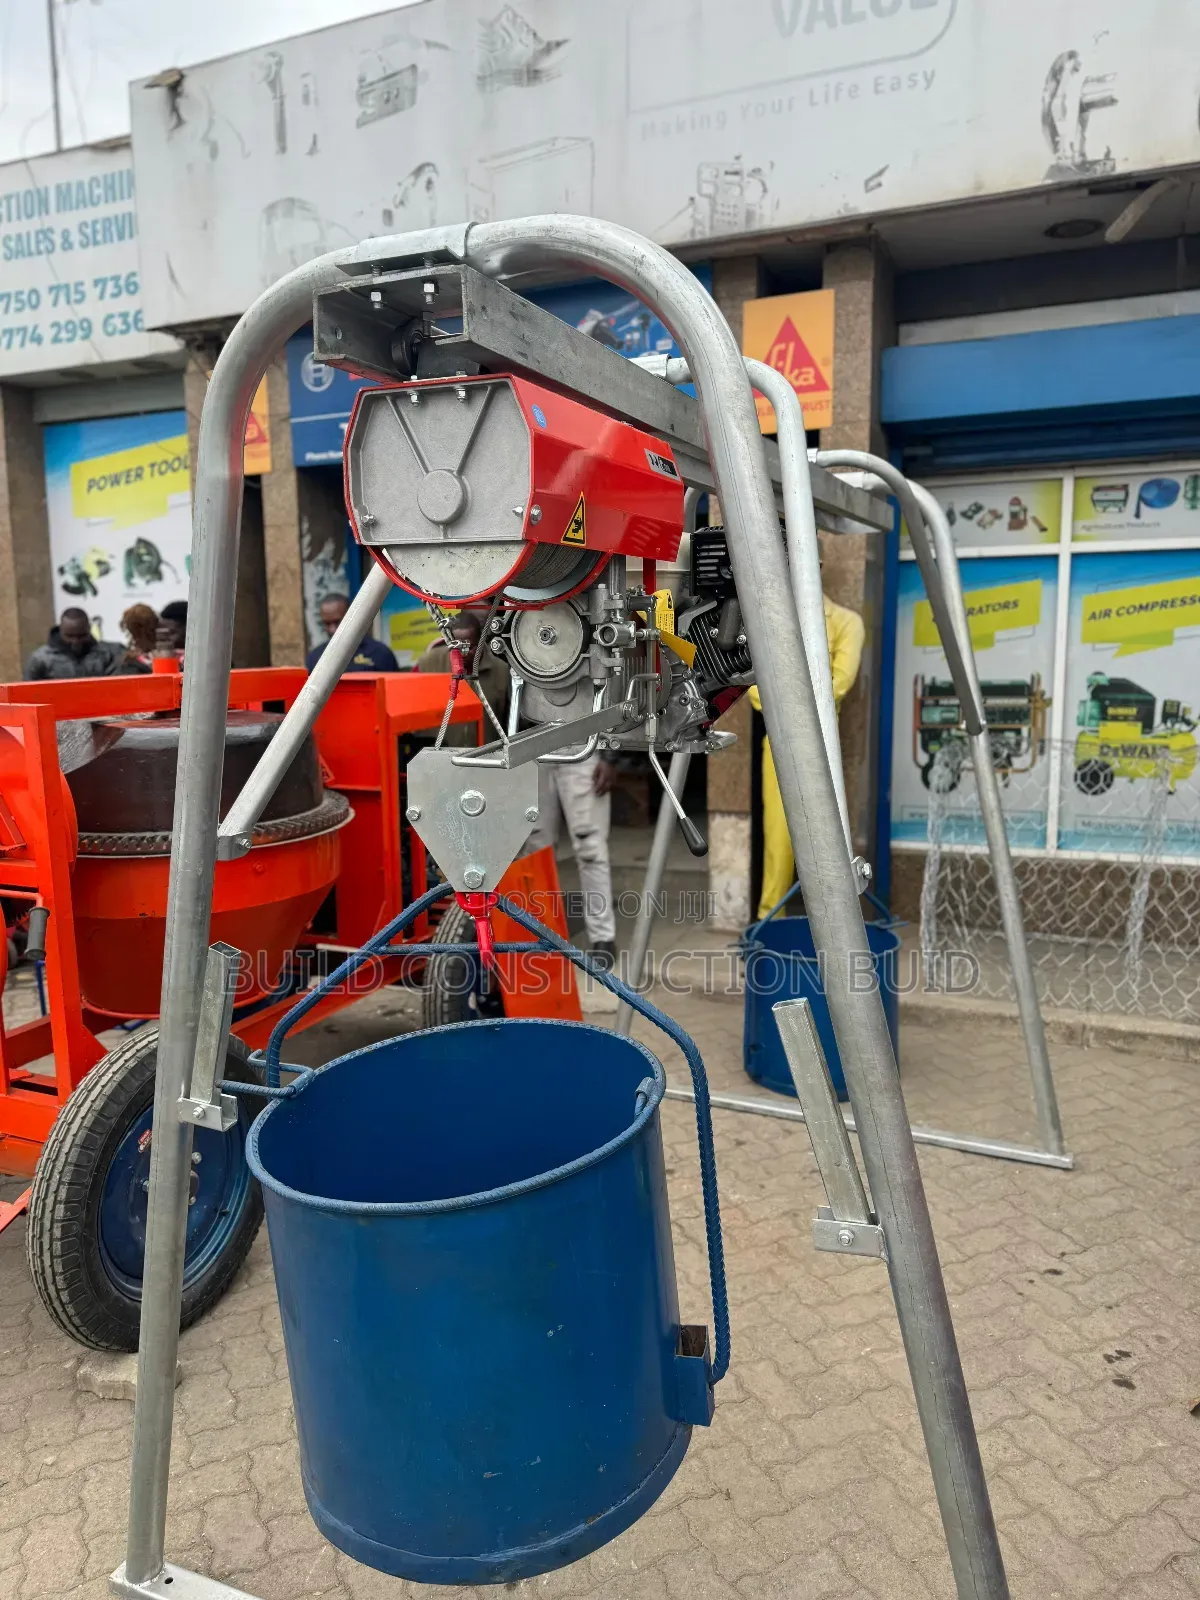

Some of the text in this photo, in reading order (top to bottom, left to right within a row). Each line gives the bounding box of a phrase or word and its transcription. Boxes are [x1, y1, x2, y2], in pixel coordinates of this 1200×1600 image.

[770, 0, 938, 39] VAL
[740, 93, 798, 121] Your
[808, 81, 860, 108] Life
[872, 68, 937, 96] Easy
[2, 211, 138, 262] SALES & SERVI
[48, 280, 87, 307] 715
[92, 271, 140, 301] 736
[0, 324, 44, 351] 774
[50, 317, 93, 345] 299
[86, 467, 145, 494] POWER
[967, 598, 1019, 618] RATORS
[1088, 594, 1200, 622] AIR COMPRESS
